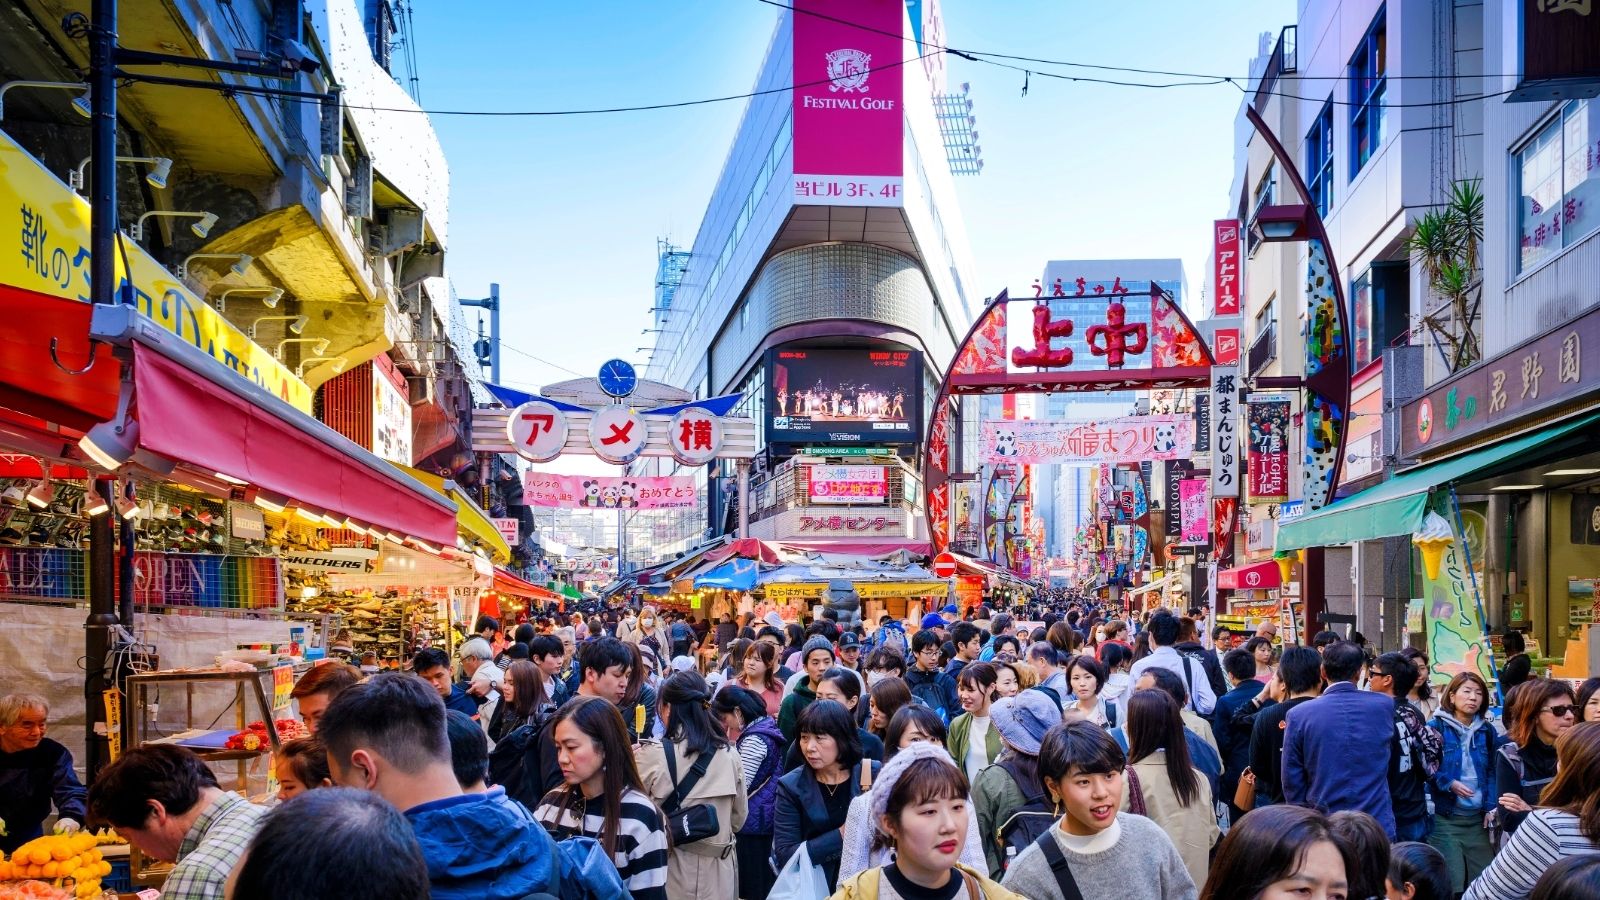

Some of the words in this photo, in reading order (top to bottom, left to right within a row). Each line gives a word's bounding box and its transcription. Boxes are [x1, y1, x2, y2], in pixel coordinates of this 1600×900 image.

[803, 96, 859, 110] FESTIVAL
[861, 97, 895, 110] GOLF
[20, 203, 71, 289] 靴の
[1011, 303, 1149, 369] 上中
[1489, 330, 1582, 414] 君野園
[521, 413, 712, 451] アメ横
[1067, 425, 1155, 457] 福まつり
[1200, 406, 1209, 449] ROOMPIA
[1215, 374, 1236, 487] 都まんじゅう
[639, 485, 695, 499] おめでとう
[1170, 473, 1180, 533] ROOMPIA
[800, 516, 899, 531] アメ横センター
[134, 556, 207, 593] OPEN
[284, 555, 362, 569] SKECHERS
